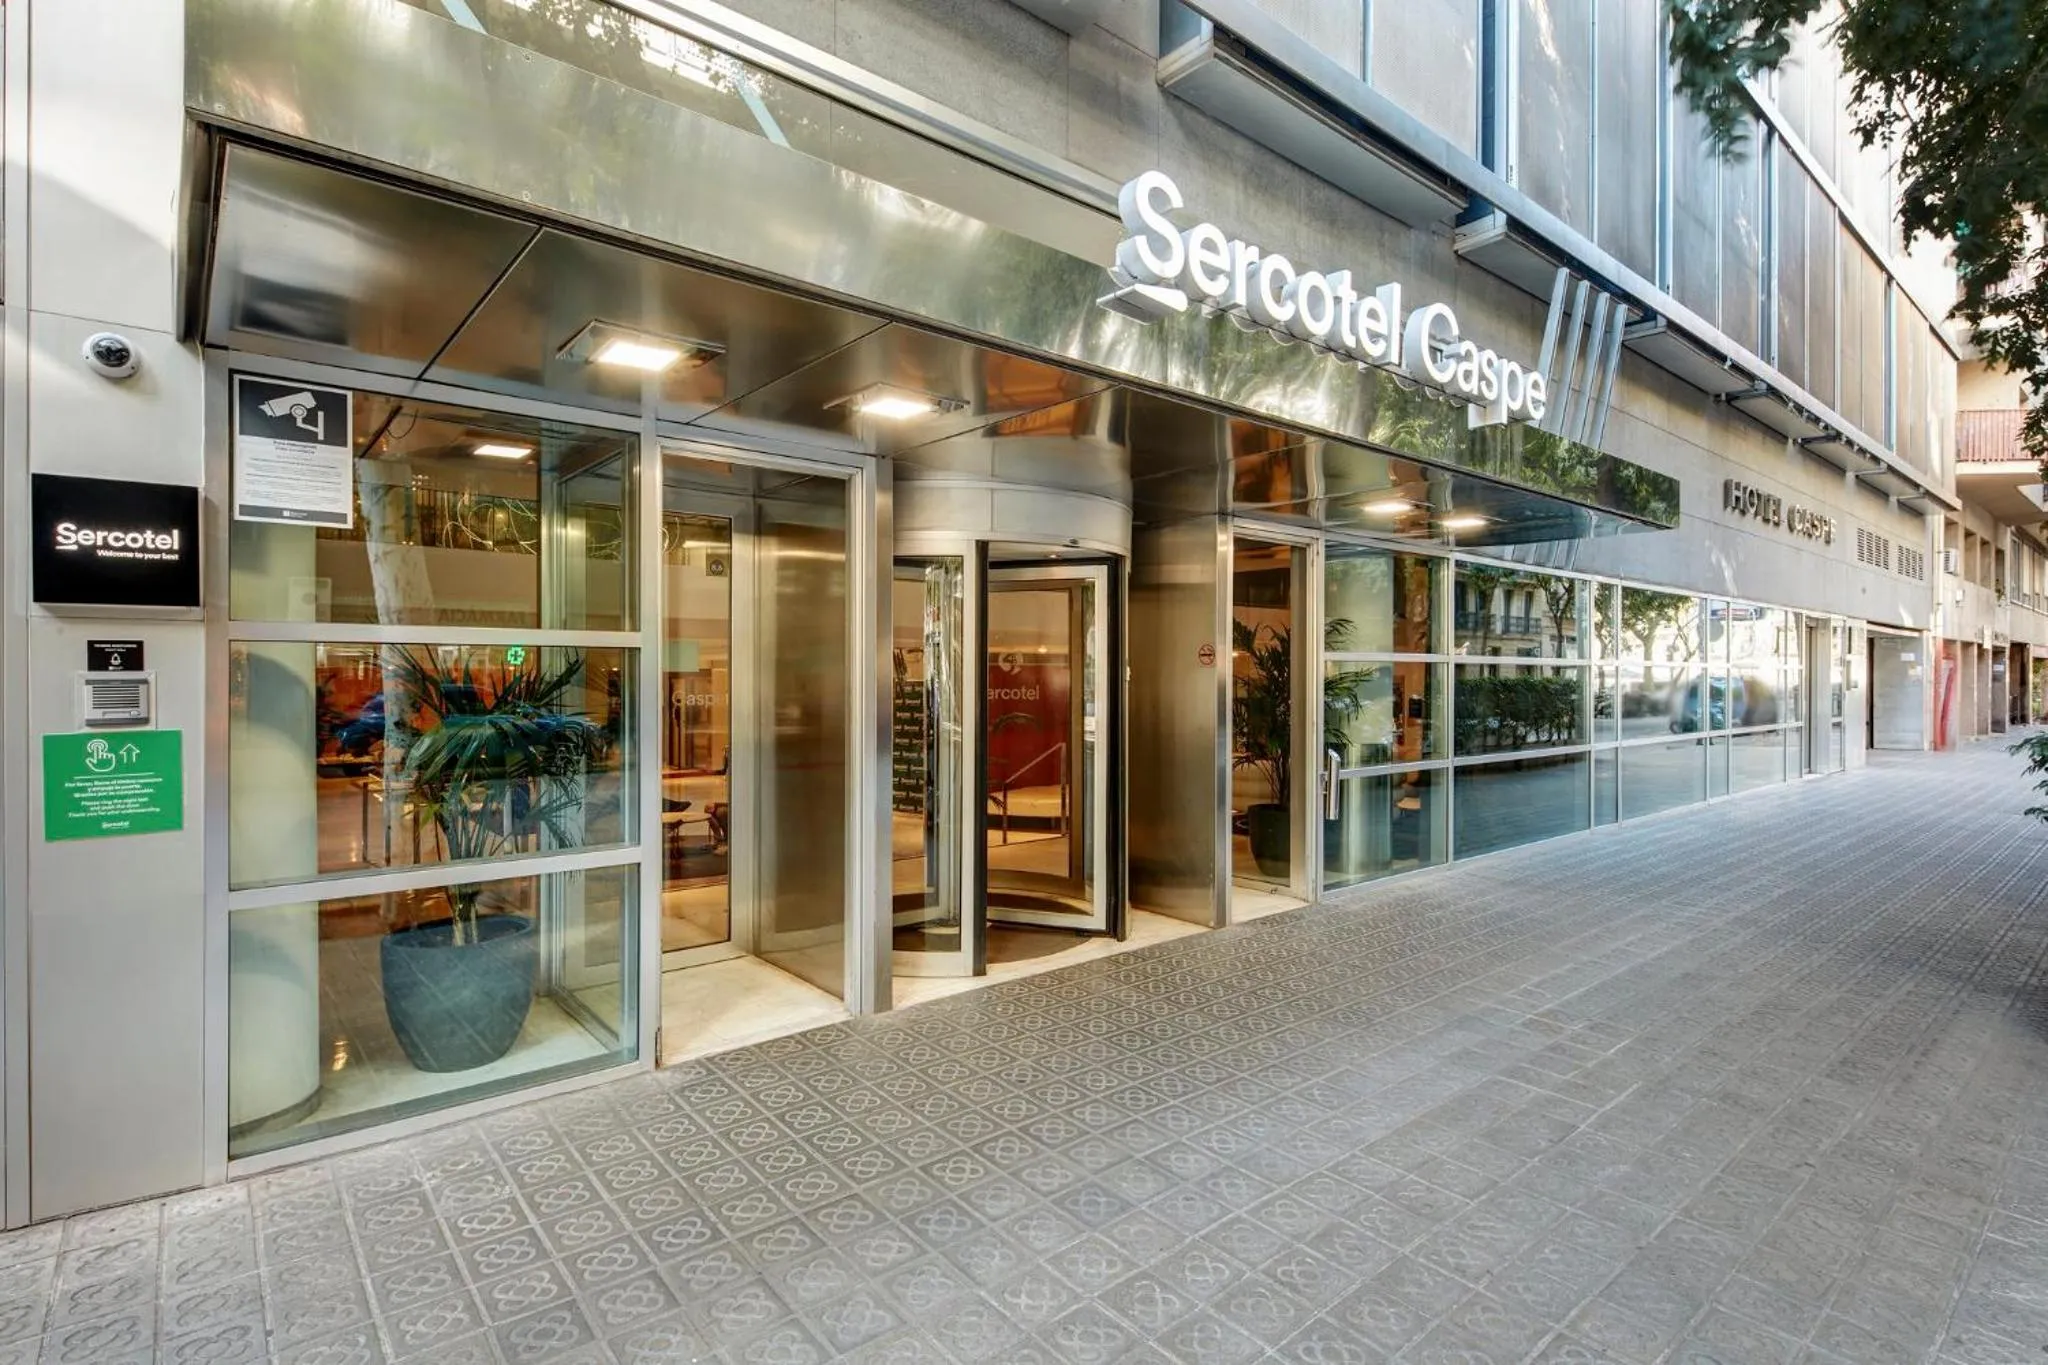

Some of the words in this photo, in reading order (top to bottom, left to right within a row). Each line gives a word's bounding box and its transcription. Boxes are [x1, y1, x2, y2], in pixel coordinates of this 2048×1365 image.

[1114, 170, 1402, 365] Sercotel
[1406, 303, 1547, 426] Caspe
[56, 522, 179, 550] Sercotel
[1786, 504, 1837, 544] CASPE
[987, 685, 1040, 701] ercotel
